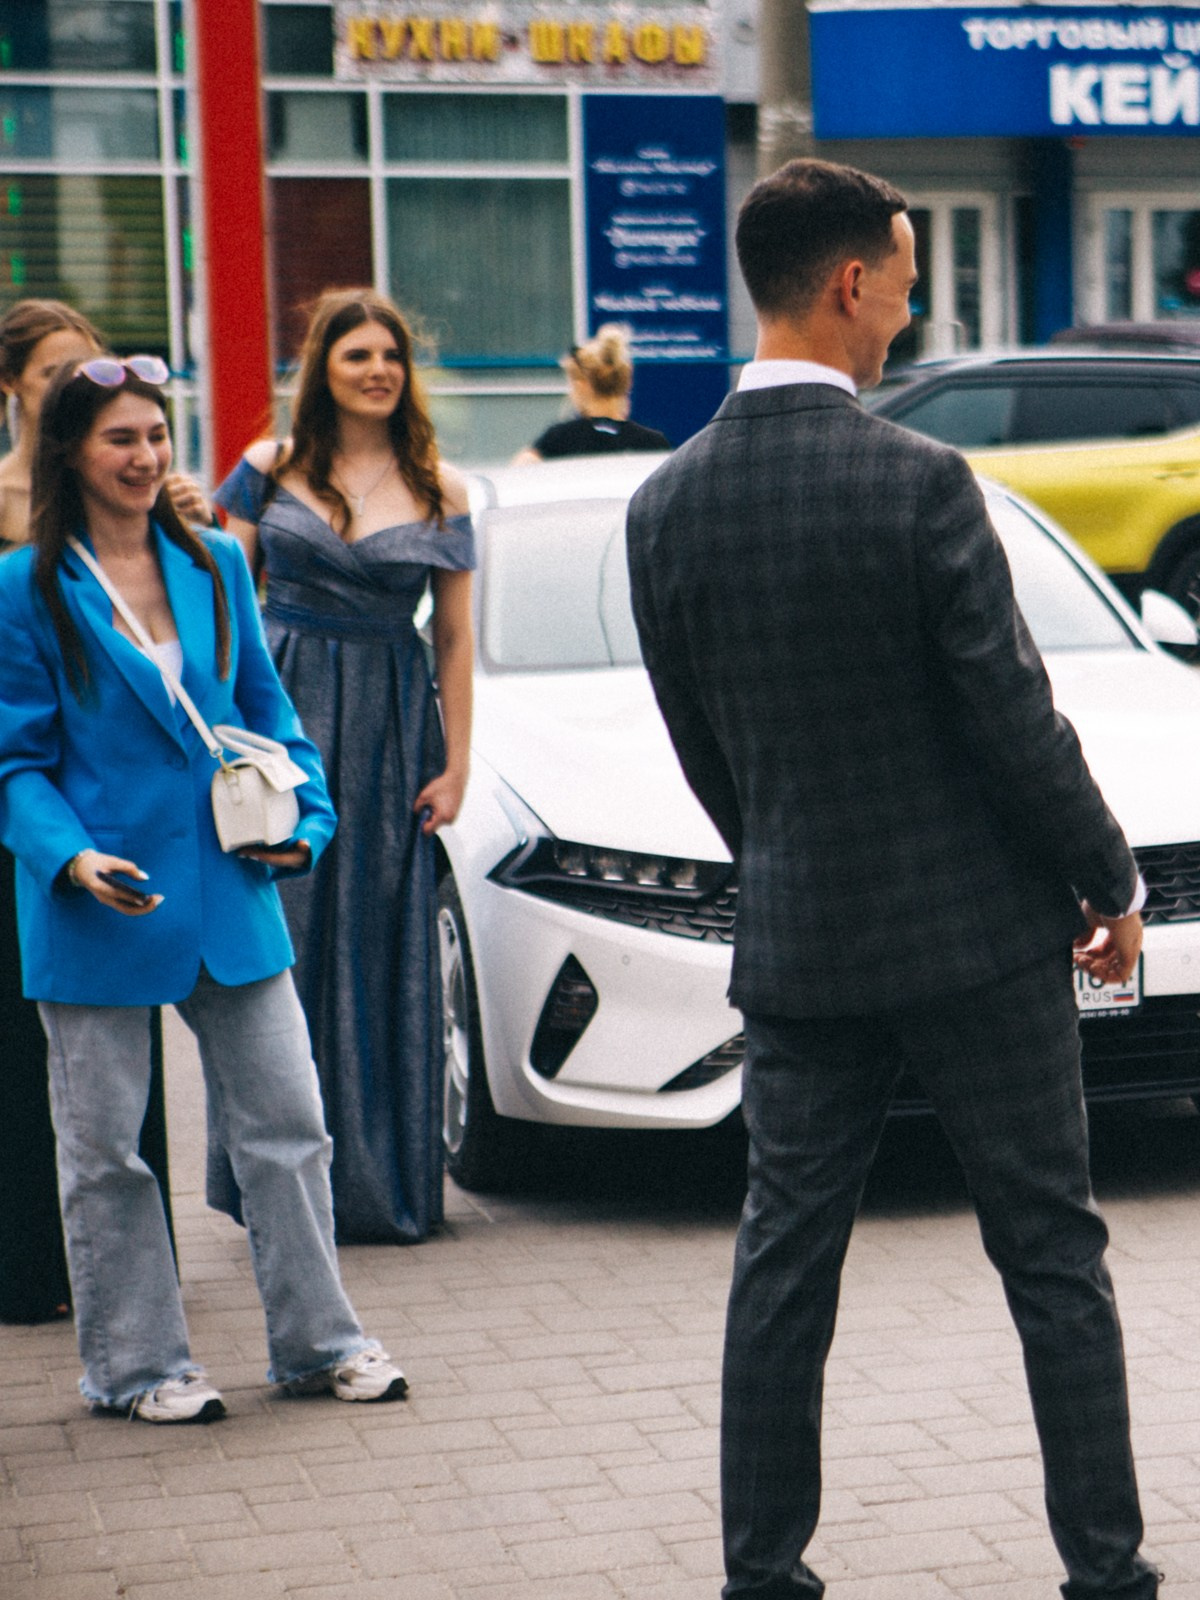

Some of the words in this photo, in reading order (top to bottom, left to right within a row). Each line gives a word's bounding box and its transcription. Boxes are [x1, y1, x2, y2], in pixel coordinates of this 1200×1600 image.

[348, 17, 498, 62] КУХНИ
[529, 20, 704, 65] ШКАФЫ
[961, 17, 1168, 50] ТОРГОВЫЙ
[1082, 991, 1112, 1004] RUS
